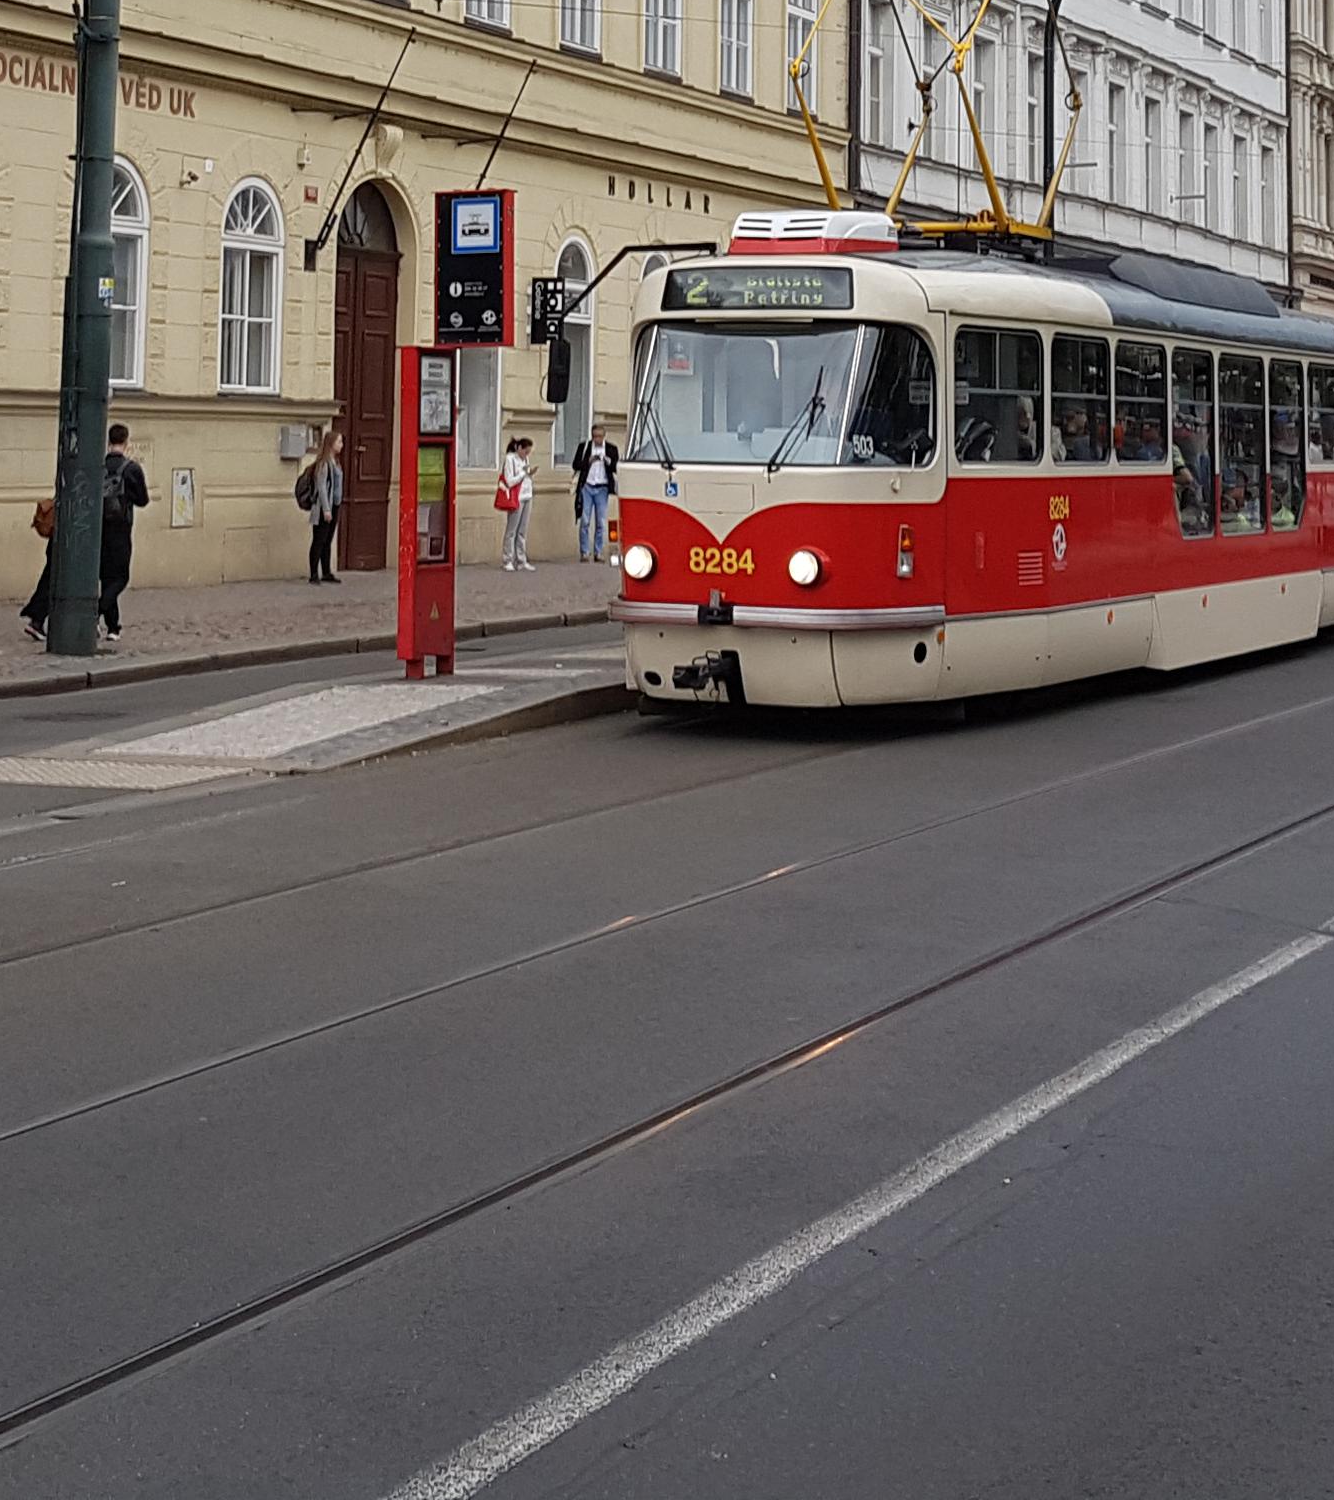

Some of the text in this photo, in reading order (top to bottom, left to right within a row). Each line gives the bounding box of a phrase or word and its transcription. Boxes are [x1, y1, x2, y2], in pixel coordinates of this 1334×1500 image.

[120, 75, 162, 111] VĚD
[169, 87, 196, 118] UK
[608, 175, 710, 214] HOLLAR
[686, 272, 709, 305] 2
[852, 434, 874, 455] 503
[1049, 494, 1070, 520] 8284
[689, 546, 755, 575] 8284
